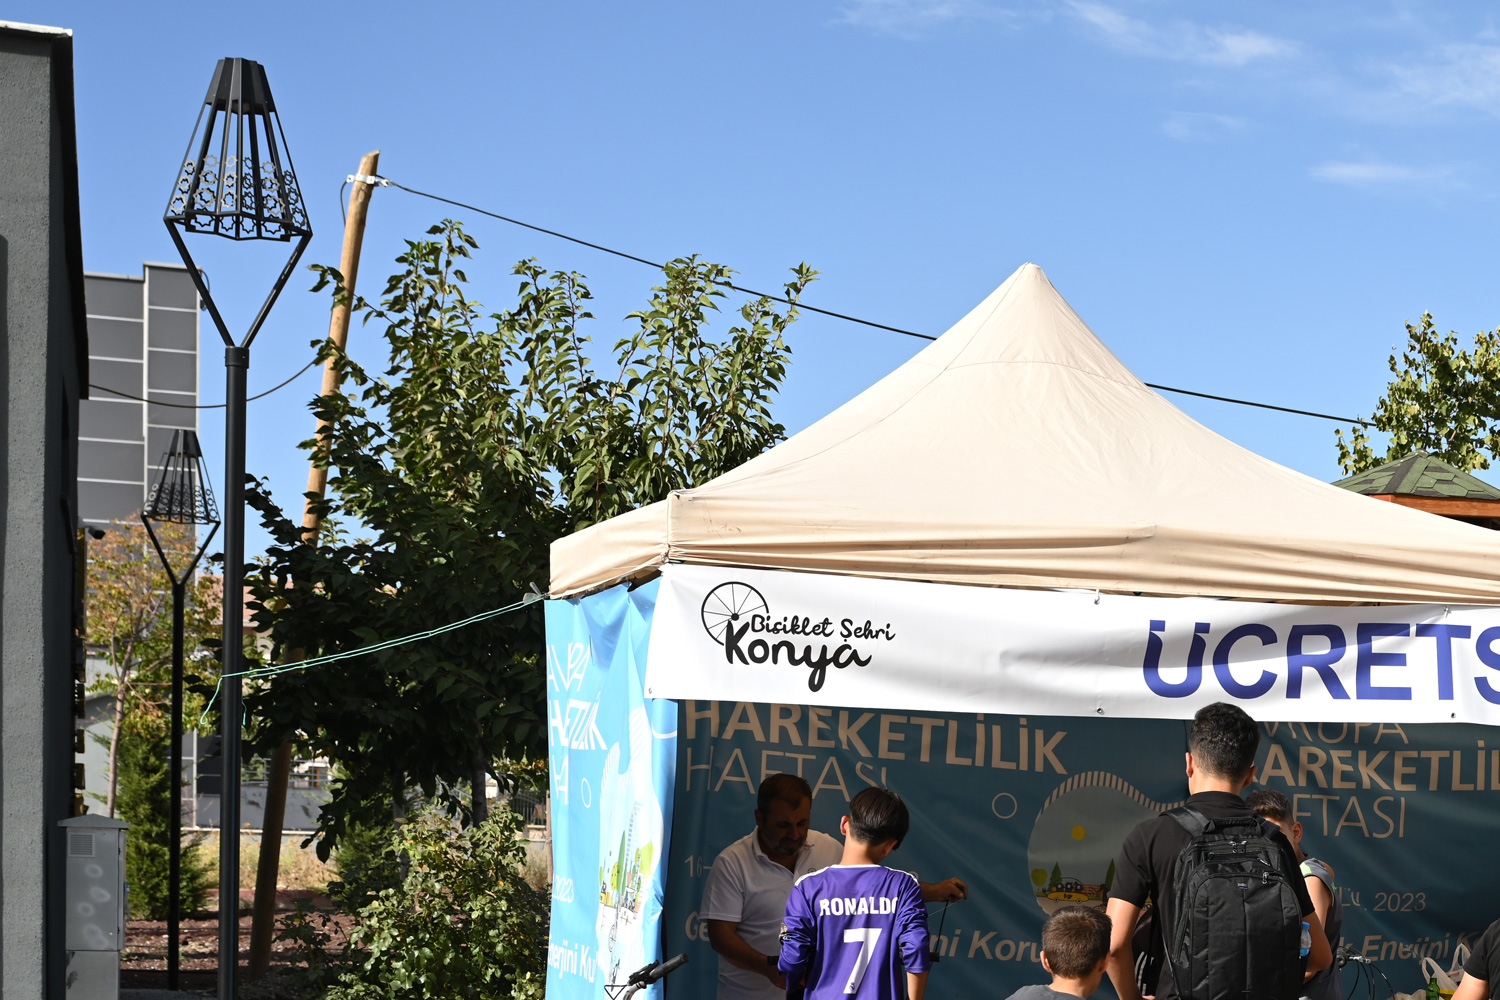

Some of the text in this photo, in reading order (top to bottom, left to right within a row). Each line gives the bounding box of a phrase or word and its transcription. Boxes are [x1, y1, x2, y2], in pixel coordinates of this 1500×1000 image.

[725, 620, 873, 693] Konya
[751, 614, 896, 643] Bisiklet Şehri
[684, 699, 1069, 775] HAREKETLİLİK
[1372, 891, 1427, 913] 2023
[843, 927, 883, 995] 7
